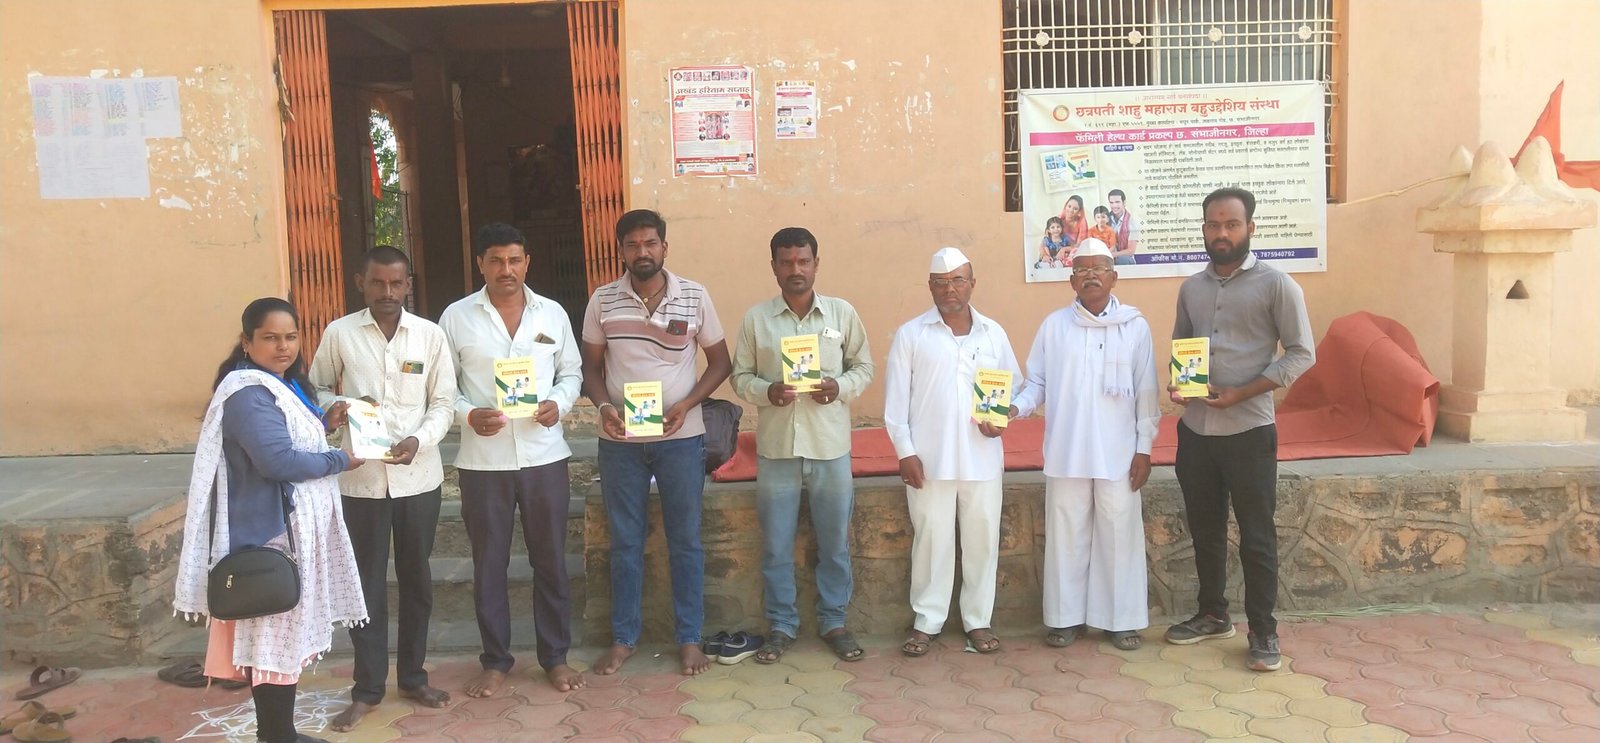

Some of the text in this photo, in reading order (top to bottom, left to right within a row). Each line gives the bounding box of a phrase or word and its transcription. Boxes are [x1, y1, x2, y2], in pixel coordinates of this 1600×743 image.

[675, 86, 697, 94] अखंड
[1076, 103, 1115, 117] छत्रपती
[1144, 103, 1187, 117] महाराज
[1190, 98, 1246, 117] बहुउद्देशिय
[1249, 97, 1280, 110] संस्था
[1075, 126, 1269, 143] फॅमिली हेल्थ कार्ड प्रकल्प छ. संभाजीनगर, जिल्हा
